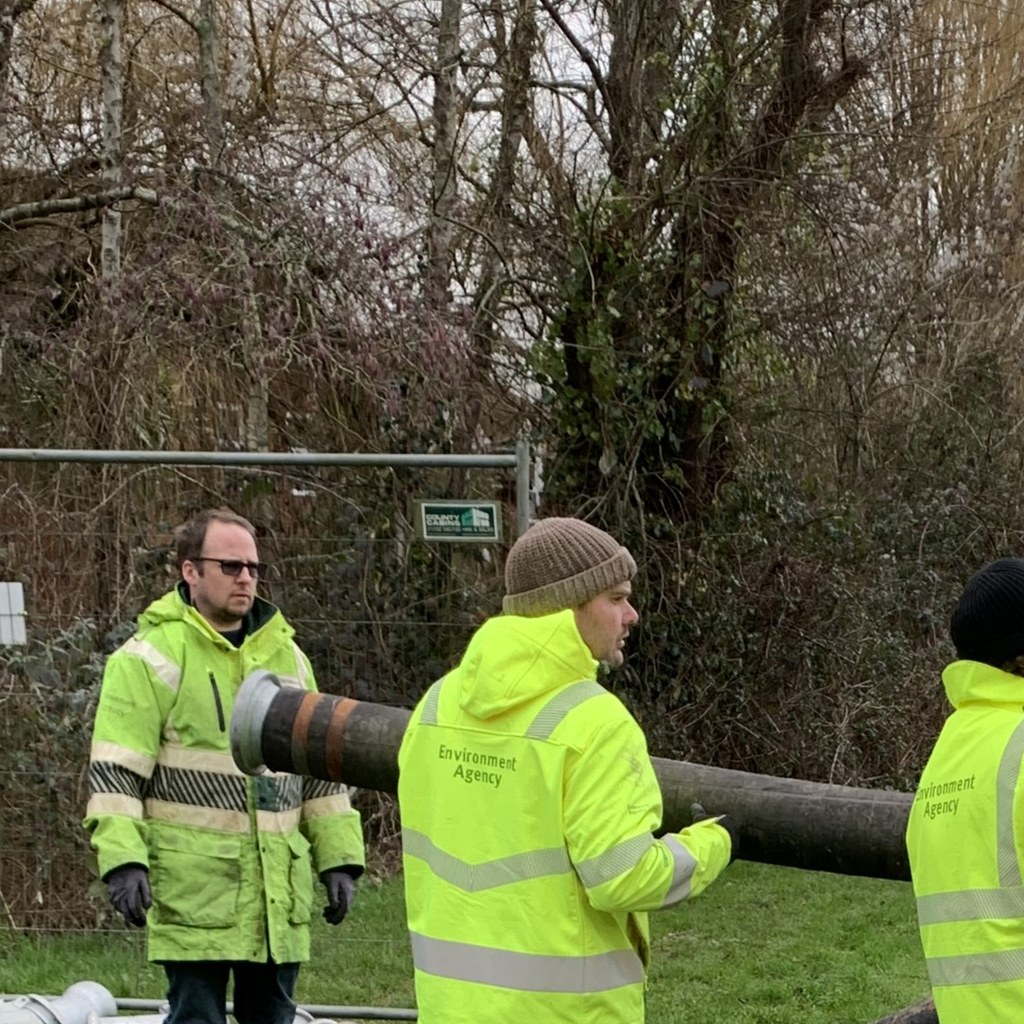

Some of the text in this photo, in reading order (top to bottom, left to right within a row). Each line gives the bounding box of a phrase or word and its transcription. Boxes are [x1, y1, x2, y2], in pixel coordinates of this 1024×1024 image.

[438, 744, 517, 772] Environment
[453, 764, 502, 789] Agency
[923, 798, 959, 820] Agency
